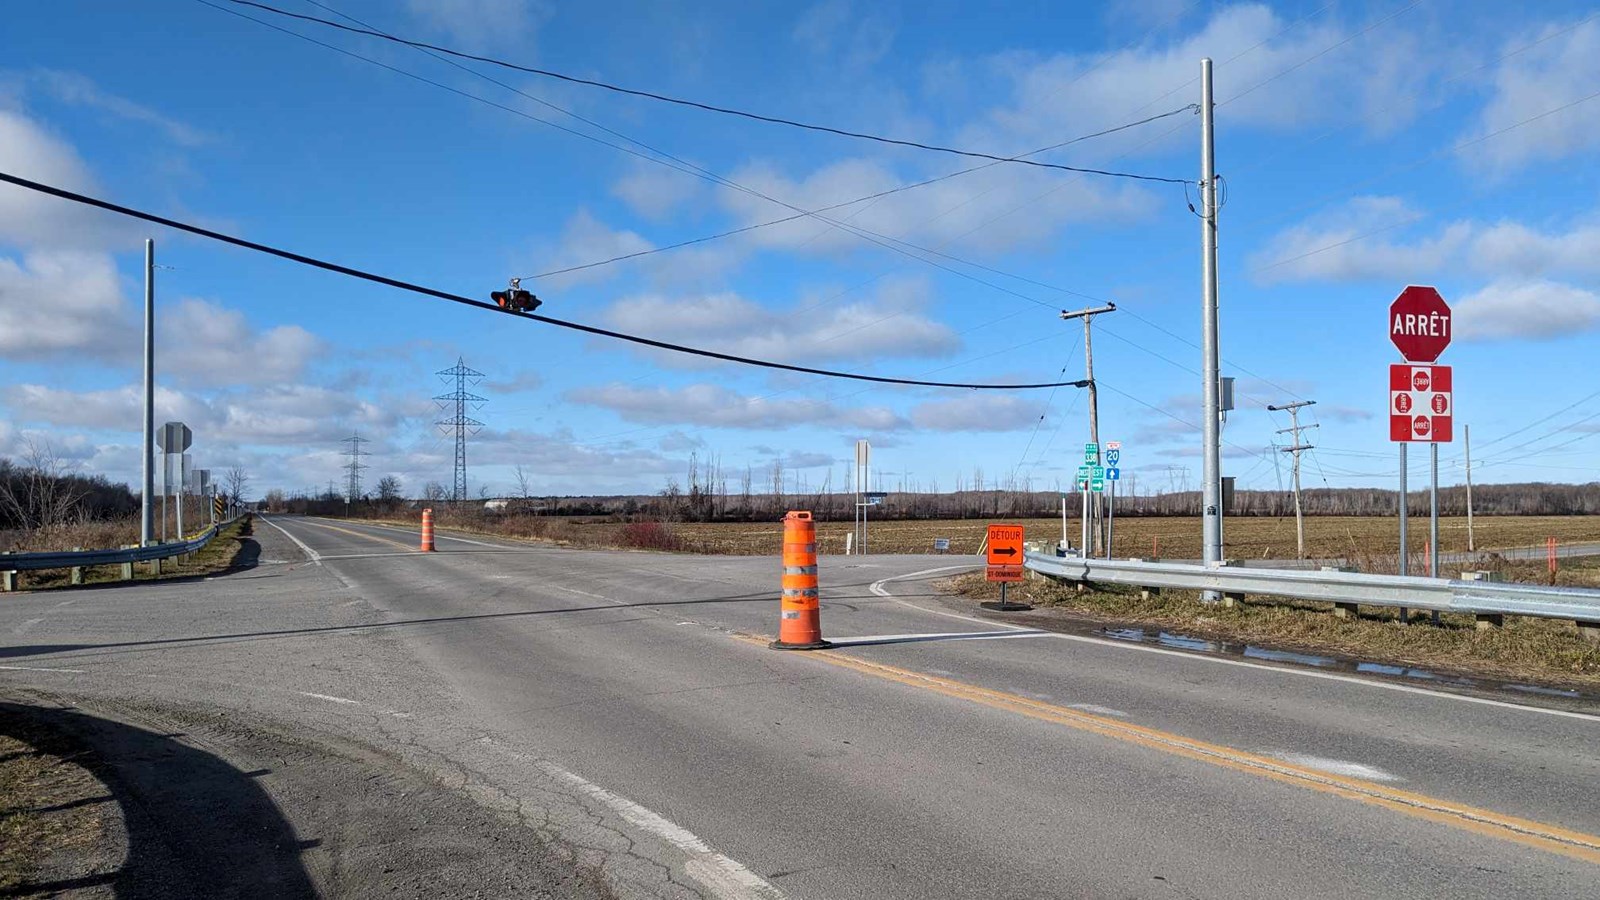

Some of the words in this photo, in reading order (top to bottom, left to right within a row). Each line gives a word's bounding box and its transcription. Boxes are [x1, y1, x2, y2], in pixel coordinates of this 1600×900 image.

[1393, 311, 1449, 337] ARRÊT
[1107, 451, 1118, 461] 20
[1093, 469, 1103, 477] EST
[991, 529, 1021, 540] DÉTOUR
